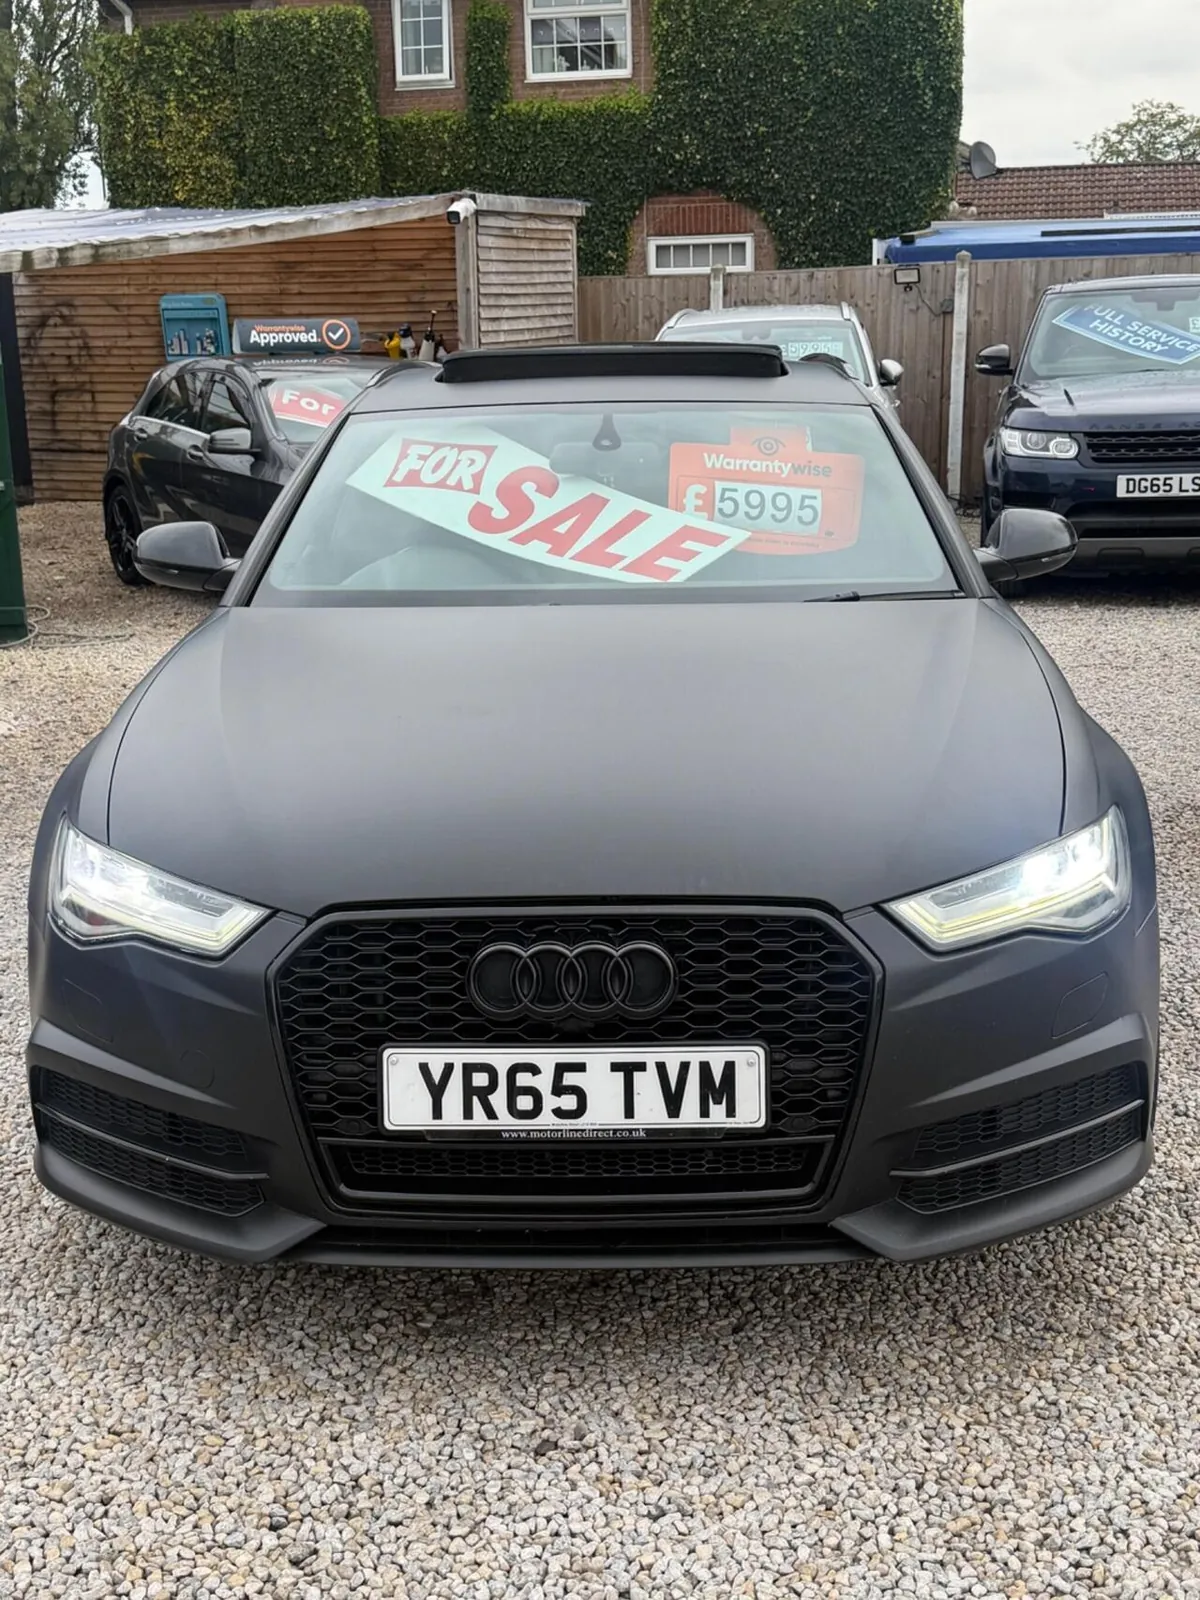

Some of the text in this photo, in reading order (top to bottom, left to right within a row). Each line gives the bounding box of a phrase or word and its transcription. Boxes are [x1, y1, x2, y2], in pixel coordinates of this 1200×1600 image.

[249, 329, 321, 347] Approved.
[1089, 319, 1169, 352] HISTORY
[1126, 320, 1200, 352] SERVICE
[703, 452, 833, 478] Warrantywise
[1125, 477, 1174, 494] DG65
[391, 444, 730, 582] FOR SALE
[418, 1060, 736, 1121] YR65 TVM
[501, 1128, 647, 1140] www.motorlinedirect.co.uk
